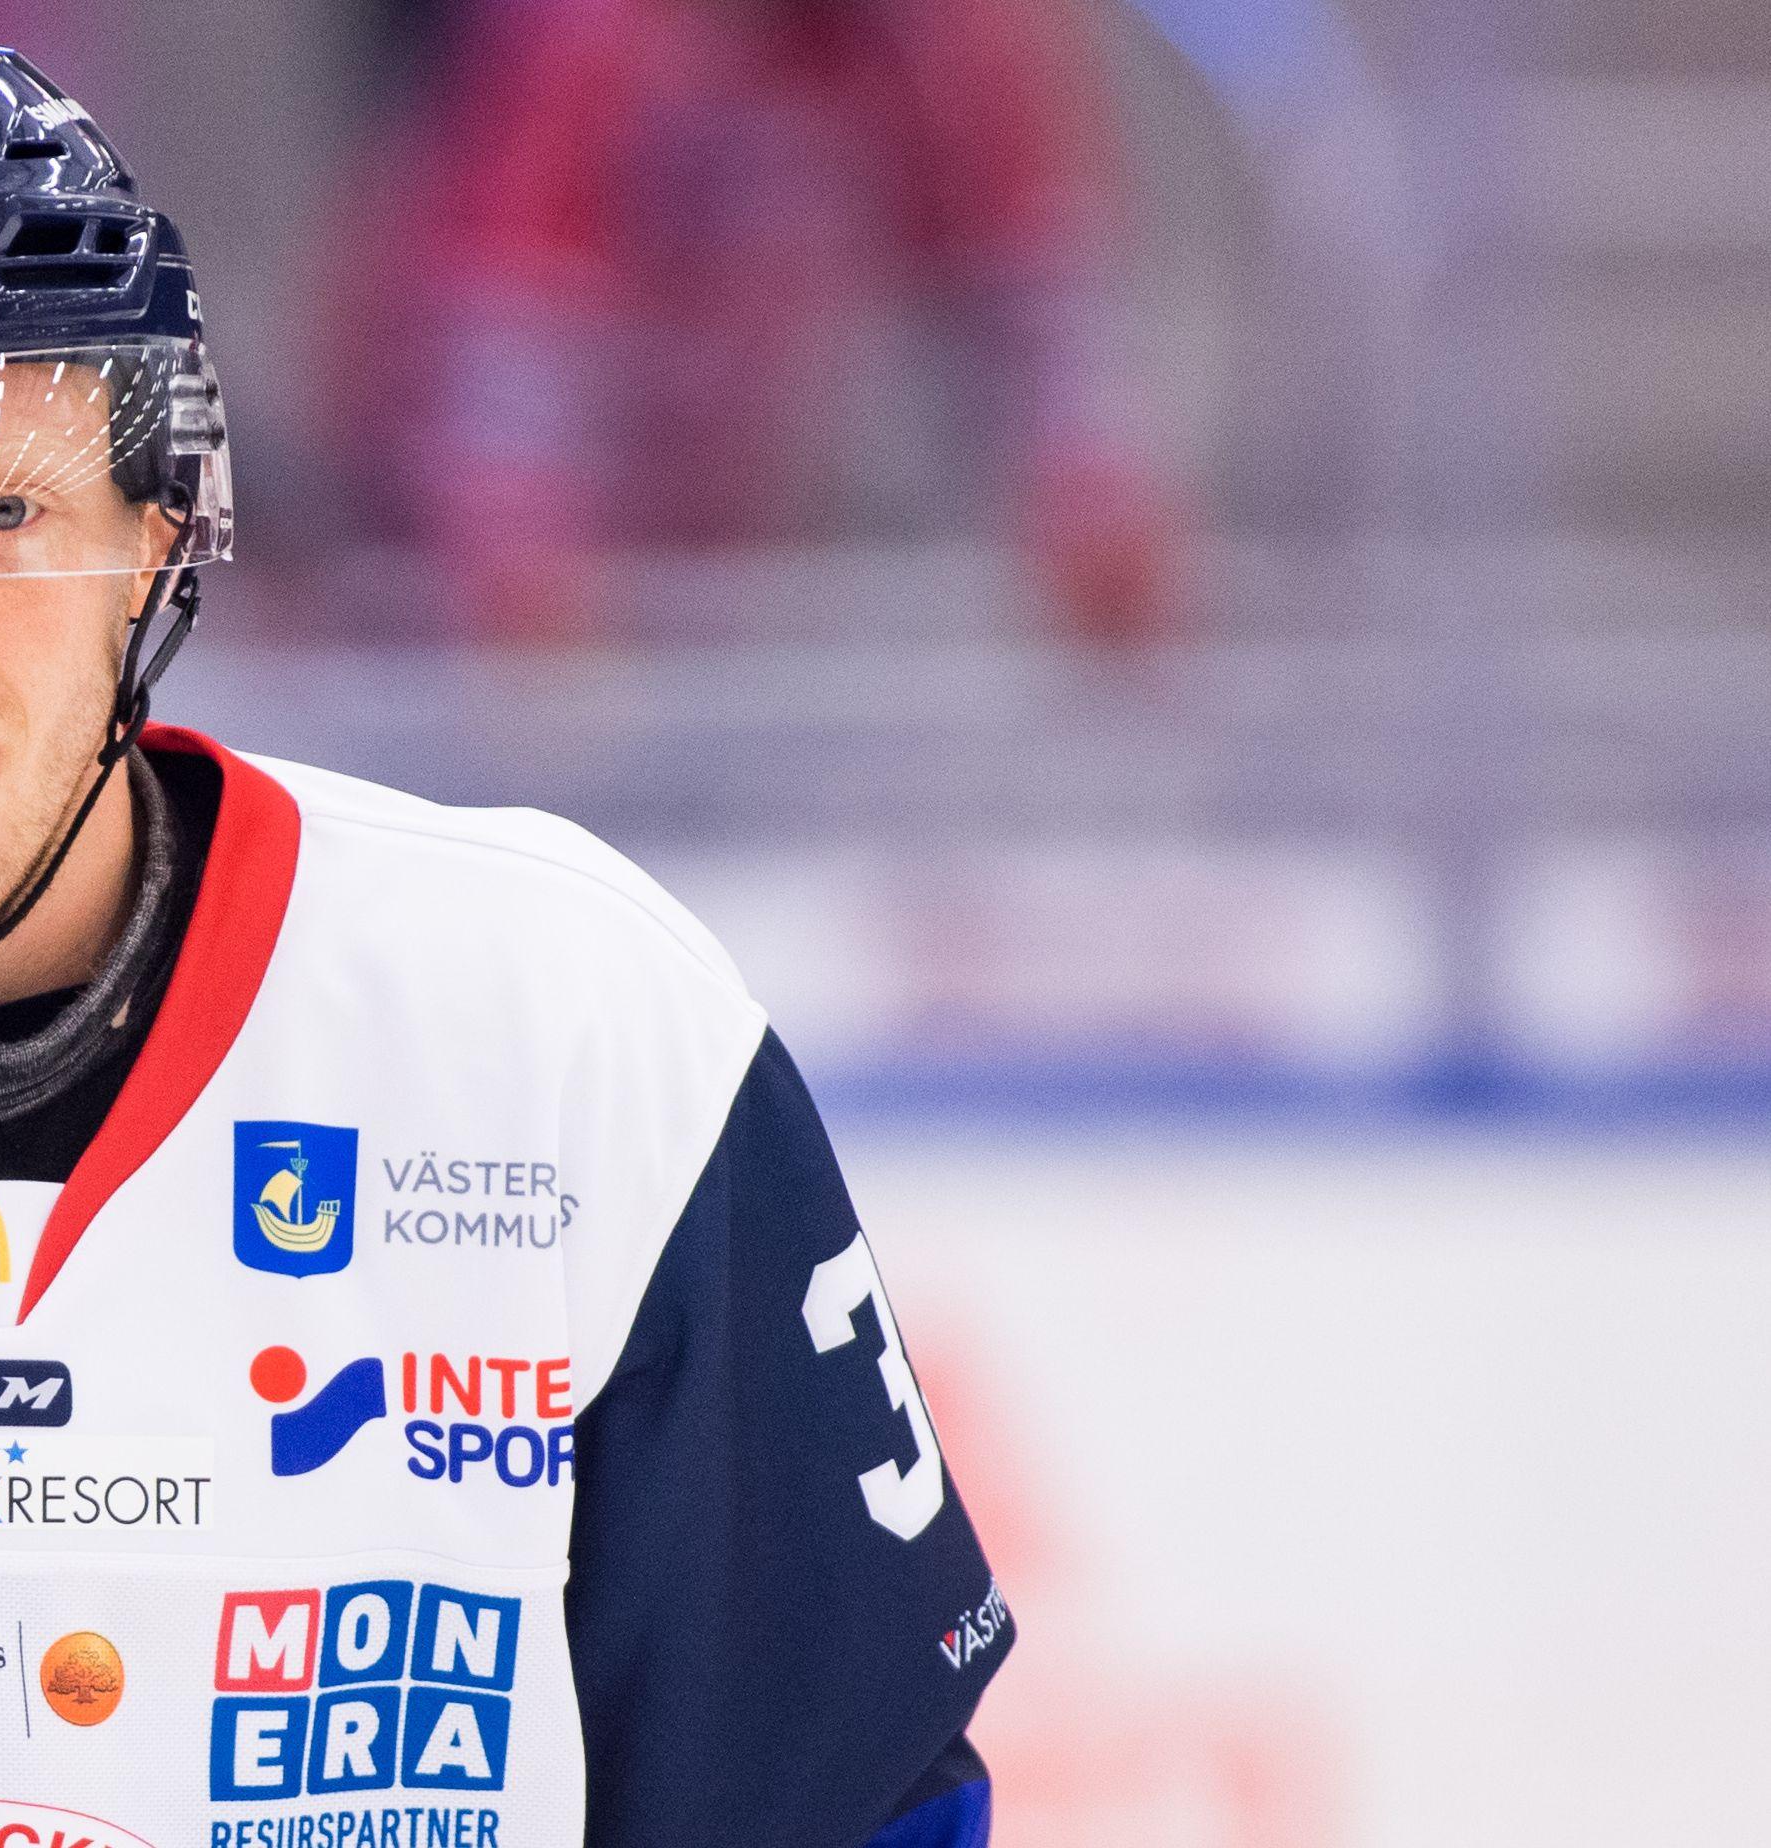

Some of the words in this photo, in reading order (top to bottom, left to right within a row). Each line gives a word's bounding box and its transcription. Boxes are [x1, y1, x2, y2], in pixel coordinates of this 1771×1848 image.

[384, 1209, 557, 1249] KOMMU
[402, 1351, 573, 1420] INTE
[801, 1230, 944, 1542] 3
[404, 1419, 575, 1488] SPOR
[211, 1807, 500, 1848] RESURSPARTNER
